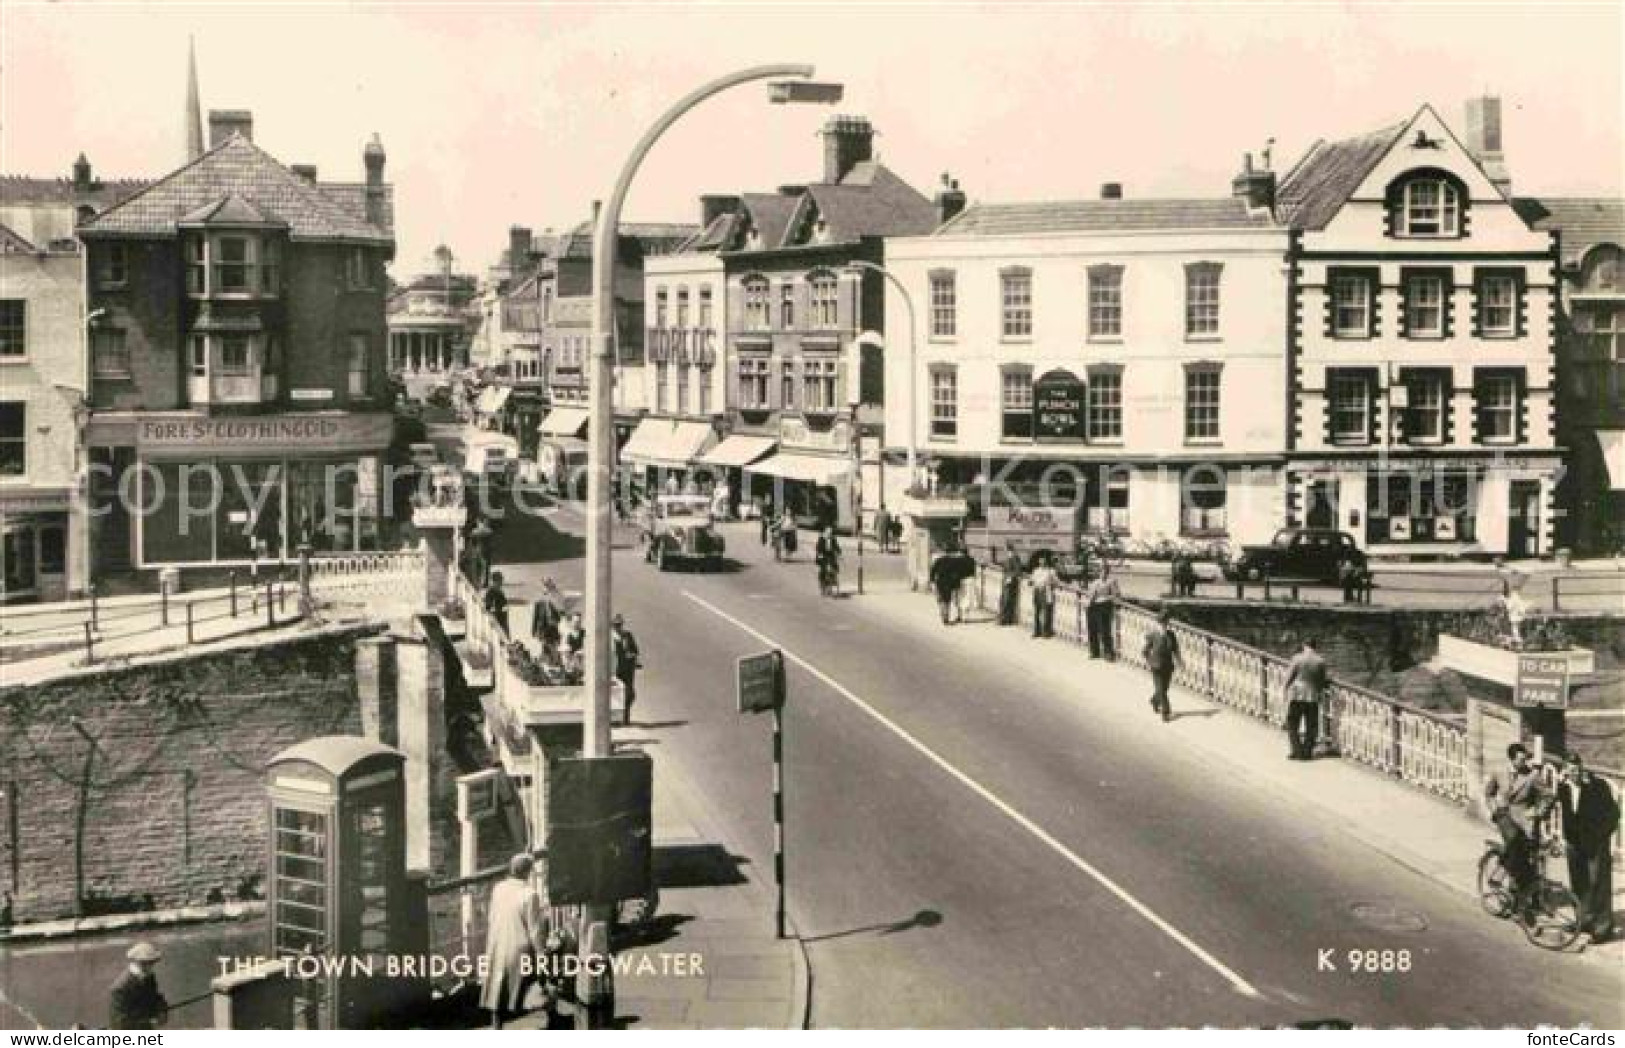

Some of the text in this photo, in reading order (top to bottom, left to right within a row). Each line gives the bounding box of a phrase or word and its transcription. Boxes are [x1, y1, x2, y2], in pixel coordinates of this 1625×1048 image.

[1039, 400, 1079, 410] PUNCH
[1041, 413, 1078, 426] BOWL
[1521, 659, 1566, 672] TO CAR
[1522, 688, 1560, 701] PARK
